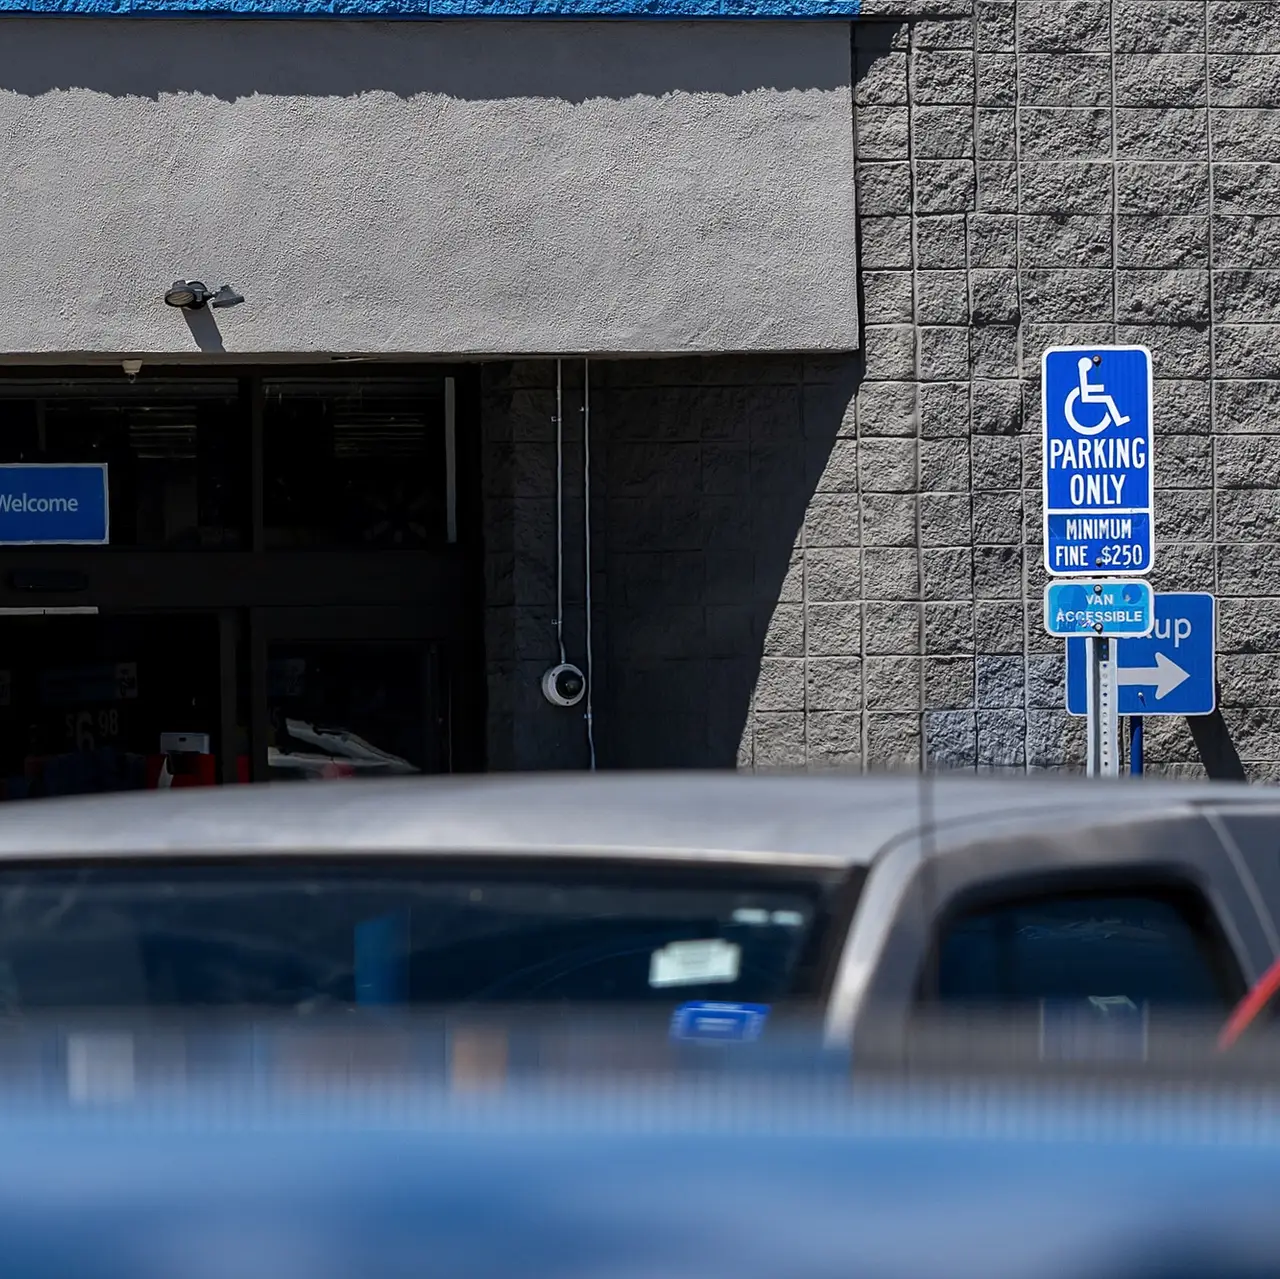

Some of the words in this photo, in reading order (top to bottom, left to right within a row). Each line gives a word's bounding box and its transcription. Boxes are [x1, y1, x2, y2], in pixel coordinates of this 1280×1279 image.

[1050, 437, 1146, 469] PARKING
[1070, 473, 1126, 506] ONLY
[1066, 518, 1132, 540] MINIMUM
[1055, 545, 1089, 566] FINE
[1101, 544, 1143, 566] $250
[1085, 594, 1114, 605] VAN
[1056, 610, 1143, 623] ACCESSIBLE
